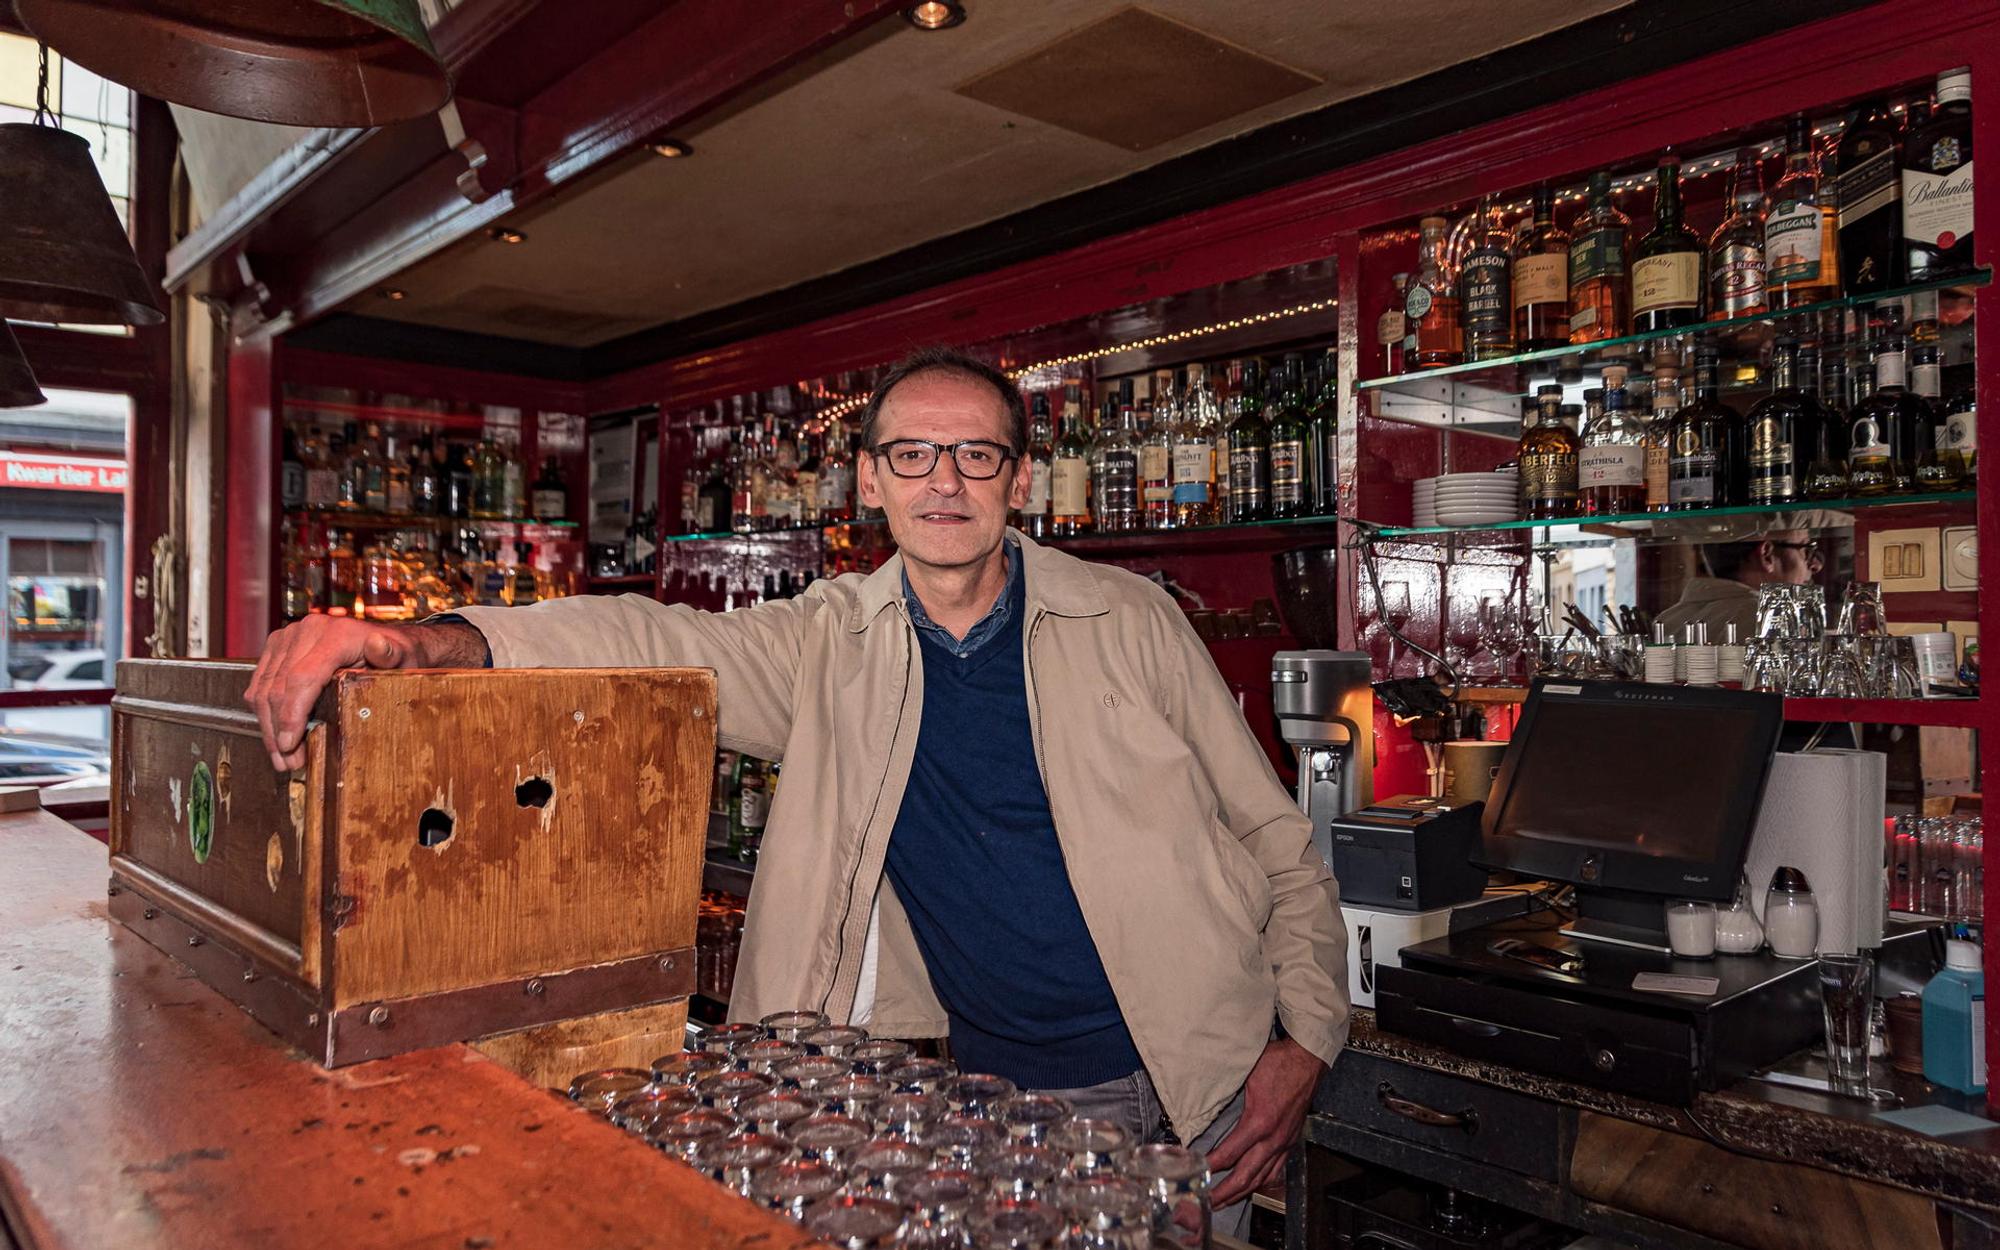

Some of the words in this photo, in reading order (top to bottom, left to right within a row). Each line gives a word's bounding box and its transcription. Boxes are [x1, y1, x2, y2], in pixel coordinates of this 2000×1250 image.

[1463, 255, 1506, 273] JAMESON
[1736, 260, 1766, 274] REGAL
[1469, 284, 1497, 298] BLACK
[1468, 298, 1501, 312] BARREL
[7, 462, 95, 486] Kwartier
